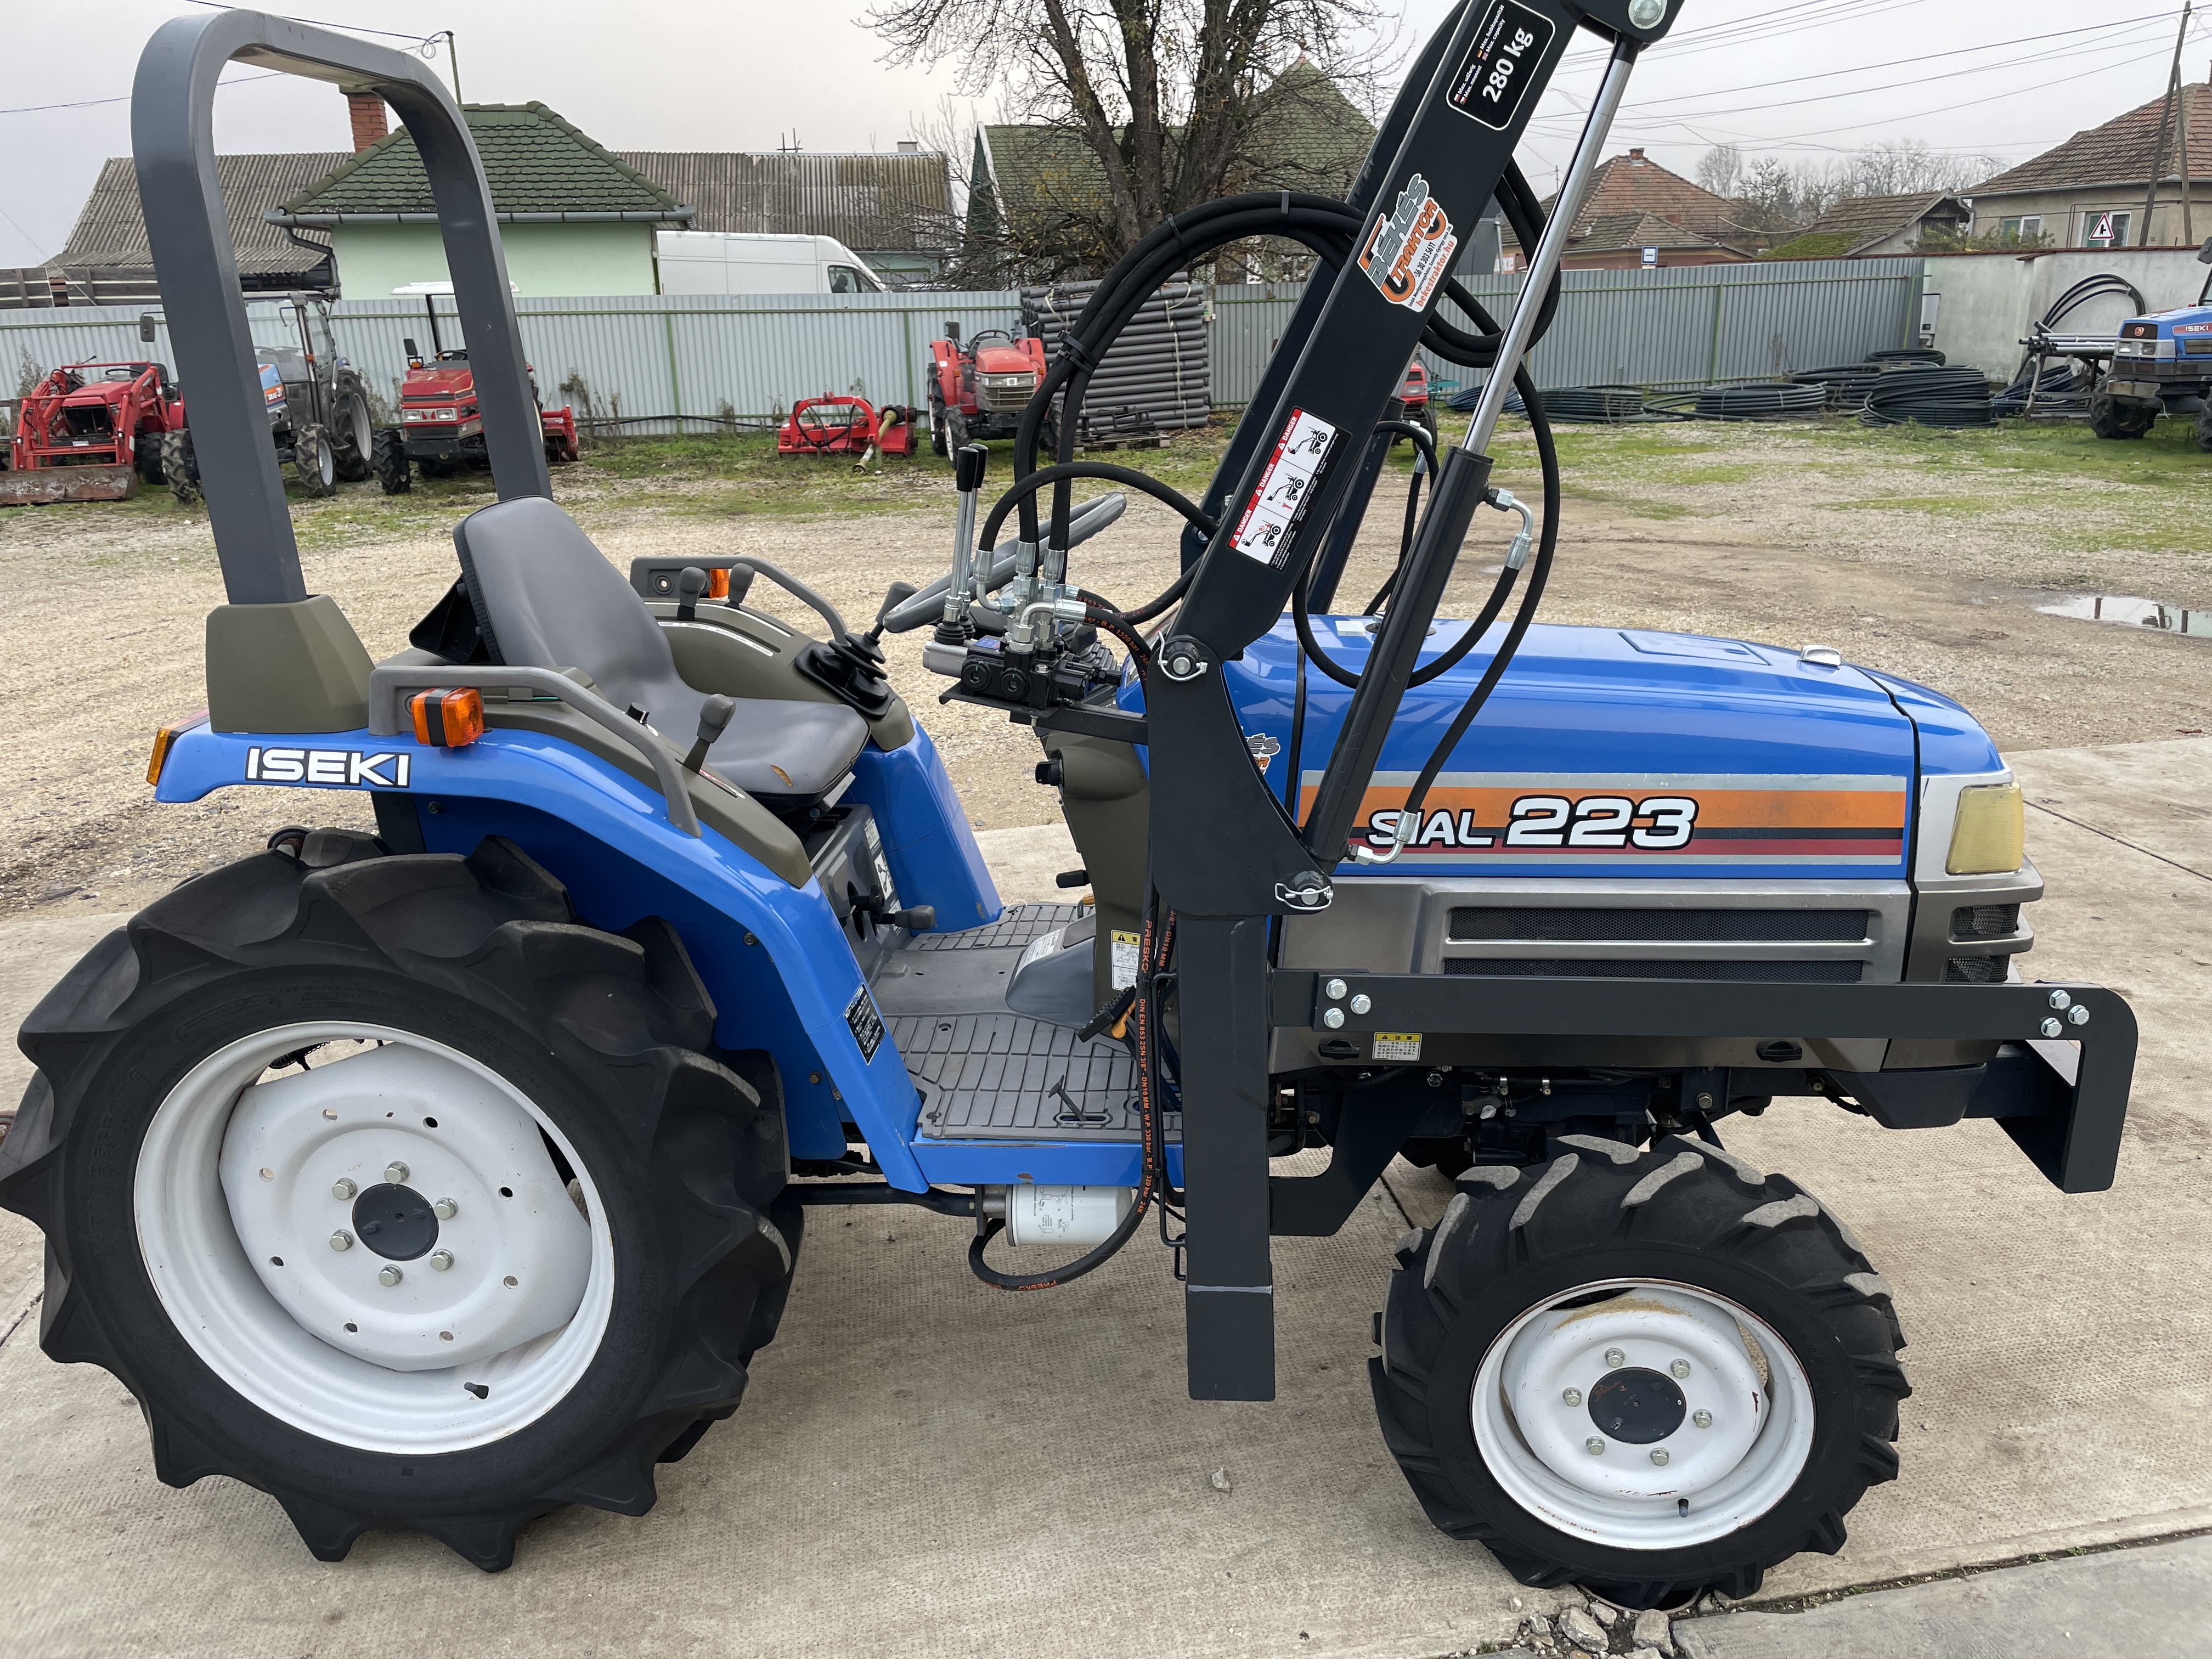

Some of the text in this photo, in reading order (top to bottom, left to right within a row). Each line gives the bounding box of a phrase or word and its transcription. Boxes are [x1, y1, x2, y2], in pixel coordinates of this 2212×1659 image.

[1479, 36, 1489, 49] Max.
[1485, 18, 1506, 53] Max. capacity
[1482, 27, 1533, 103] 280 kg
[1457, 81, 1467, 94] Max.
[1463, 84, 1472, 97] Max.
[1365, 174, 1427, 287] BÉKÉS
[1390, 198, 1438, 281] TRAKTOR
[1420, 252, 1430, 264] 303
[1425, 241, 1436, 255] 5611
[1415, 240, 1454, 307] bekestraktor.hu
[1417, 261, 1425, 270] 30
[1282, 416, 1297, 441] DANGER
[1259, 462, 1275, 488] DANGER
[1237, 509, 1252, 533] DANGER
[1115, 628, 1131, 642] 1320
[1129, 640, 1139, 652] bar
[245, 746, 411, 788] ISEKI
[1502, 794, 1699, 850] 223
[1161, 930, 1172, 952] DN10
[1158, 952, 1167, 966] MM
[1139, 1014, 1145, 1024] EN
[1142, 1096, 1149, 1108] MM
